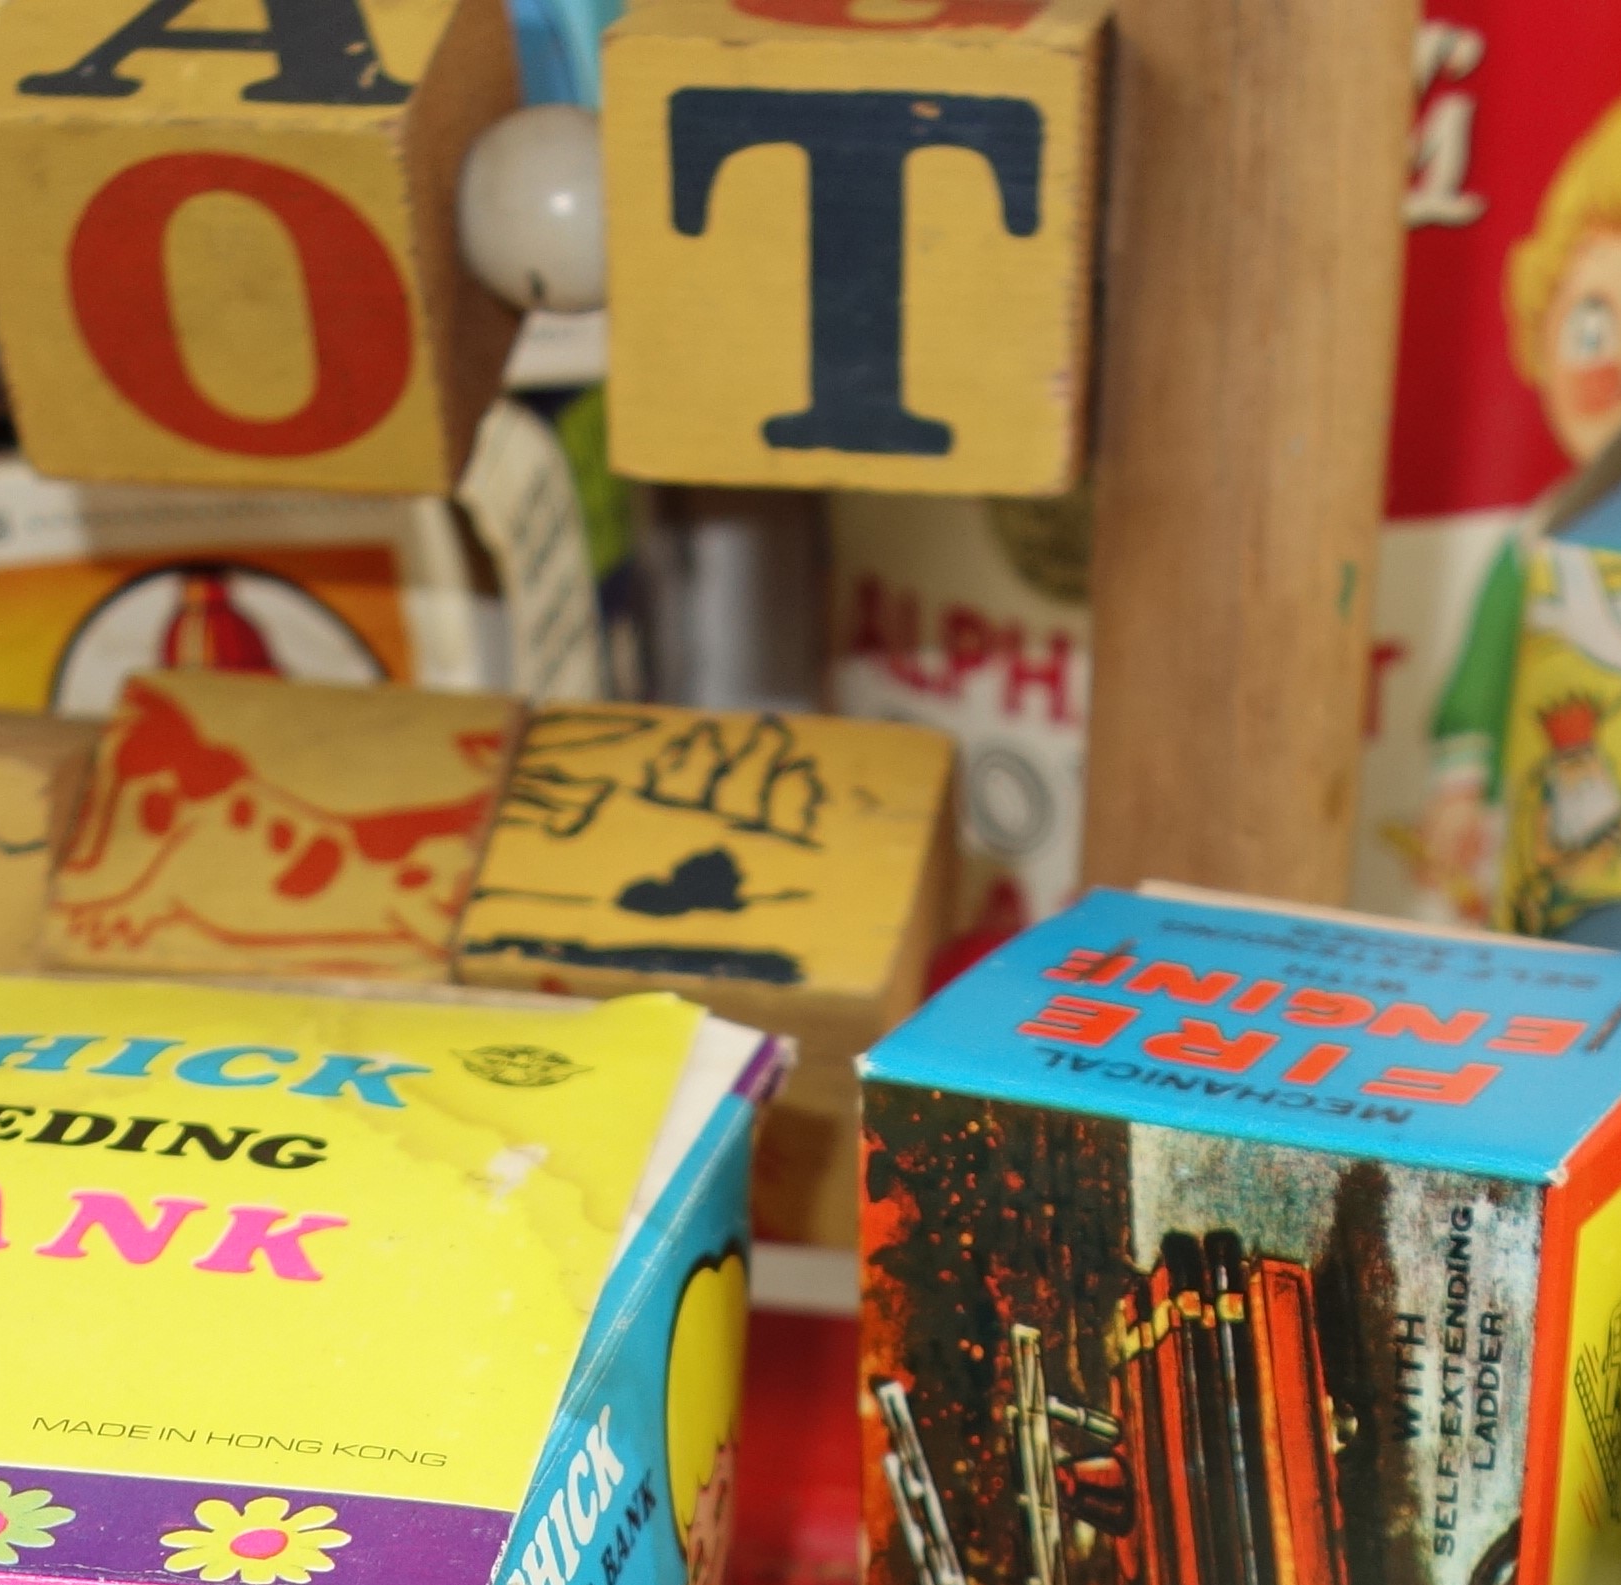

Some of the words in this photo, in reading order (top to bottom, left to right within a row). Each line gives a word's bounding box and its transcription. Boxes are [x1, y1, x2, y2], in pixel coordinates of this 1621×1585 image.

[66, 150, 413, 458] O
[668, 88, 1044, 456] T
[1017, 993, 1505, 1106] FIRE
[1041, 947, 1591, 1057] ENGINE
[1035, 1045, 1416, 1125] MECHANICAL
[1392, 1311, 1427, 1443] WITH
[1471, 1311, 1504, 1472] LADDER
[32, 1416, 153, 1440] MADE
[158, 1426, 196, 1444] IN
[206, 1430, 324, 1455] HONG
[332, 1442, 448, 1468] KONG
